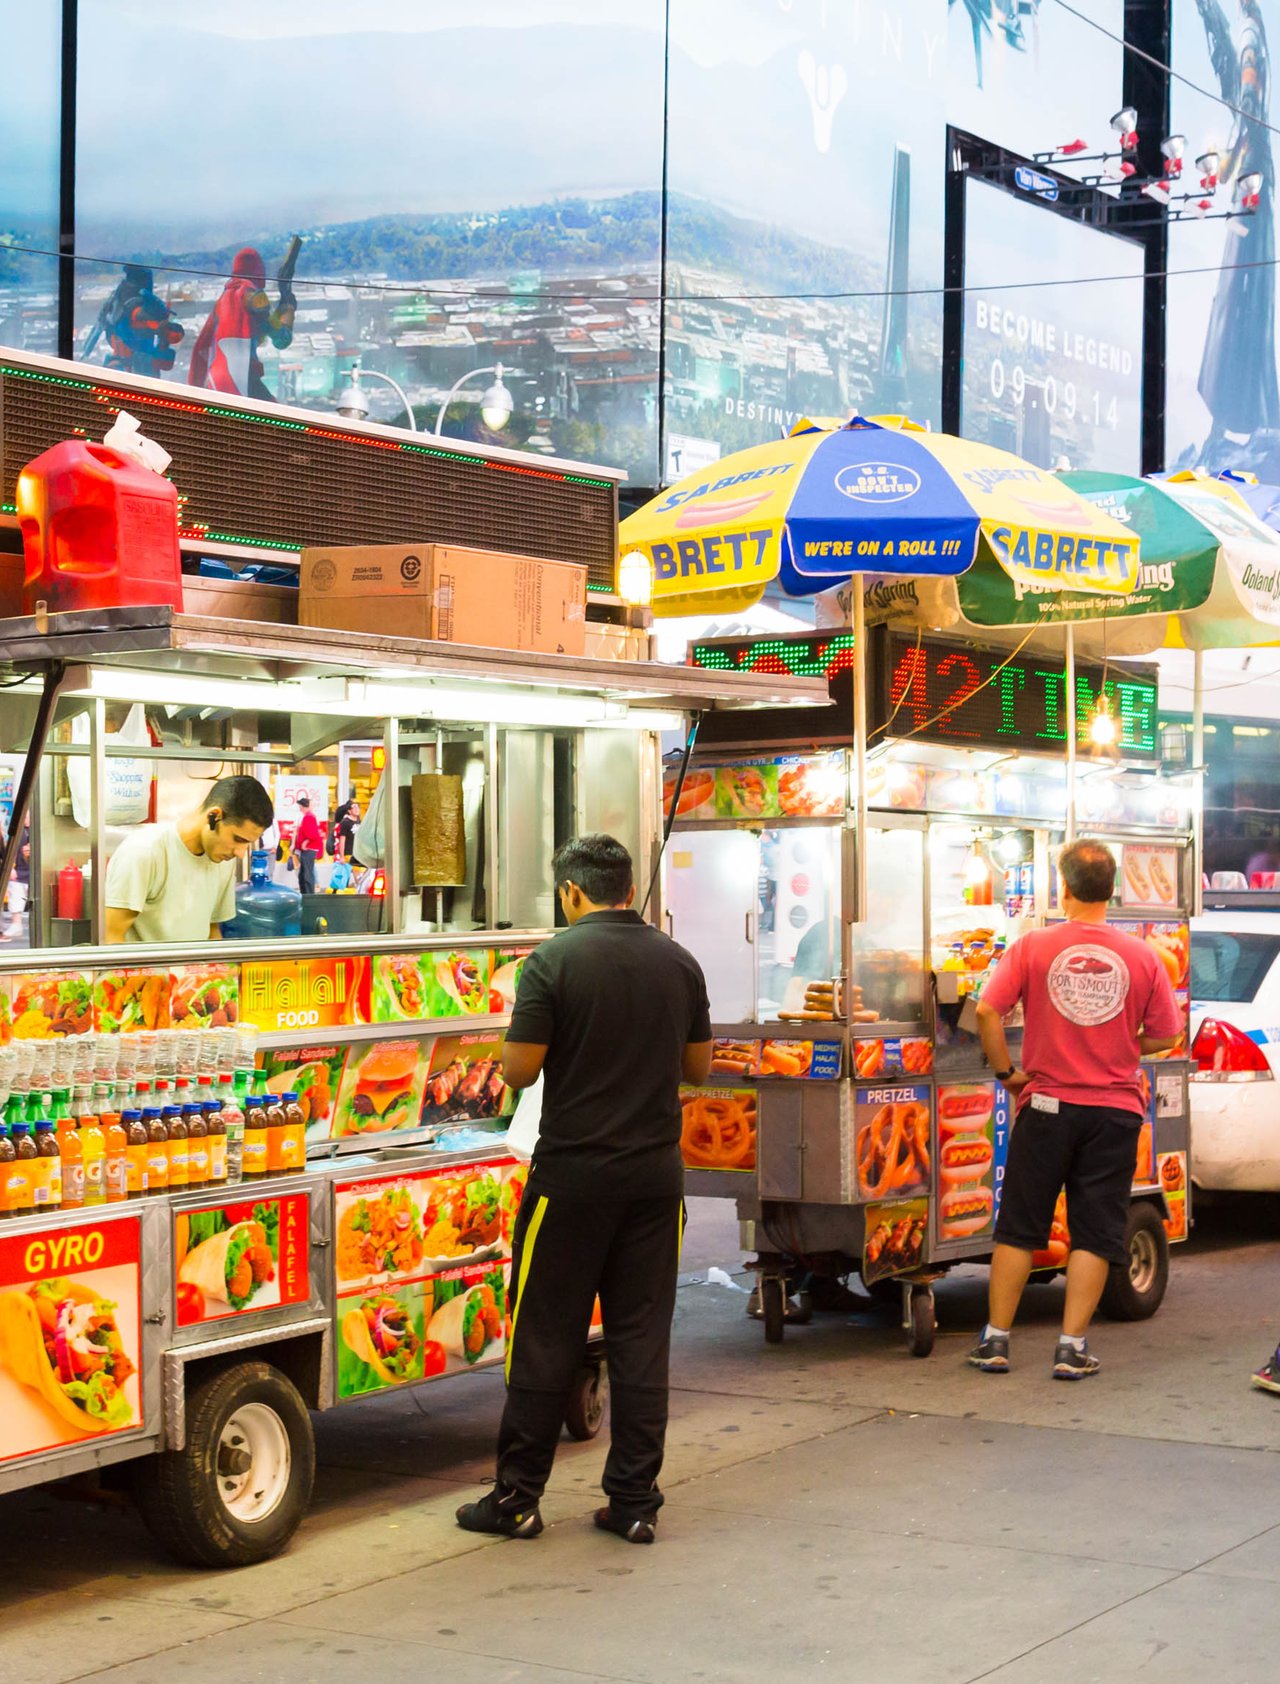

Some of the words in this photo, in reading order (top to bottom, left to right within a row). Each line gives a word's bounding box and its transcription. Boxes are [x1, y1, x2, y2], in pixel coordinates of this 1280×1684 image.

[976, 300, 1056, 352] BECOME
[1063, 330, 1133, 376] LEGEND
[990, 358, 1119, 431] 09.09.14
[655, 463, 794, 513] SABRETT
[846, 484, 915, 494] INSPECTED
[805, 541, 854, 557] WE'RE
[857, 541, 880, 556] ON
[883, 540, 894, 556] A
[898, 541, 937, 557] ROLL
[941, 540, 961, 556] !!!
[992, 527, 1131, 579] SABRETT
[1062, 599, 1094, 610] Natural
[1095, 597, 1126, 609] Spring
[1126, 594, 1152, 605] Water
[246, 962, 346, 1011] Halal
[277, 1010, 319, 1028] FOOD
[300, 1047, 337, 1060] Sandwich
[814, 1066, 835, 1074] FOOD
[702, 1089, 735, 1099] PRETZEL
[867, 1088, 918, 1104] PRETZEL
[995, 1089, 1006, 1147] HOT
[474, 1165, 490, 1174] Rice
[397, 1178, 414, 1188] Rice
[25, 1231, 104, 1274] GYRO
[286, 1201, 296, 1297] FALAFEL
[463, 1262, 495, 1277] Sandwich
